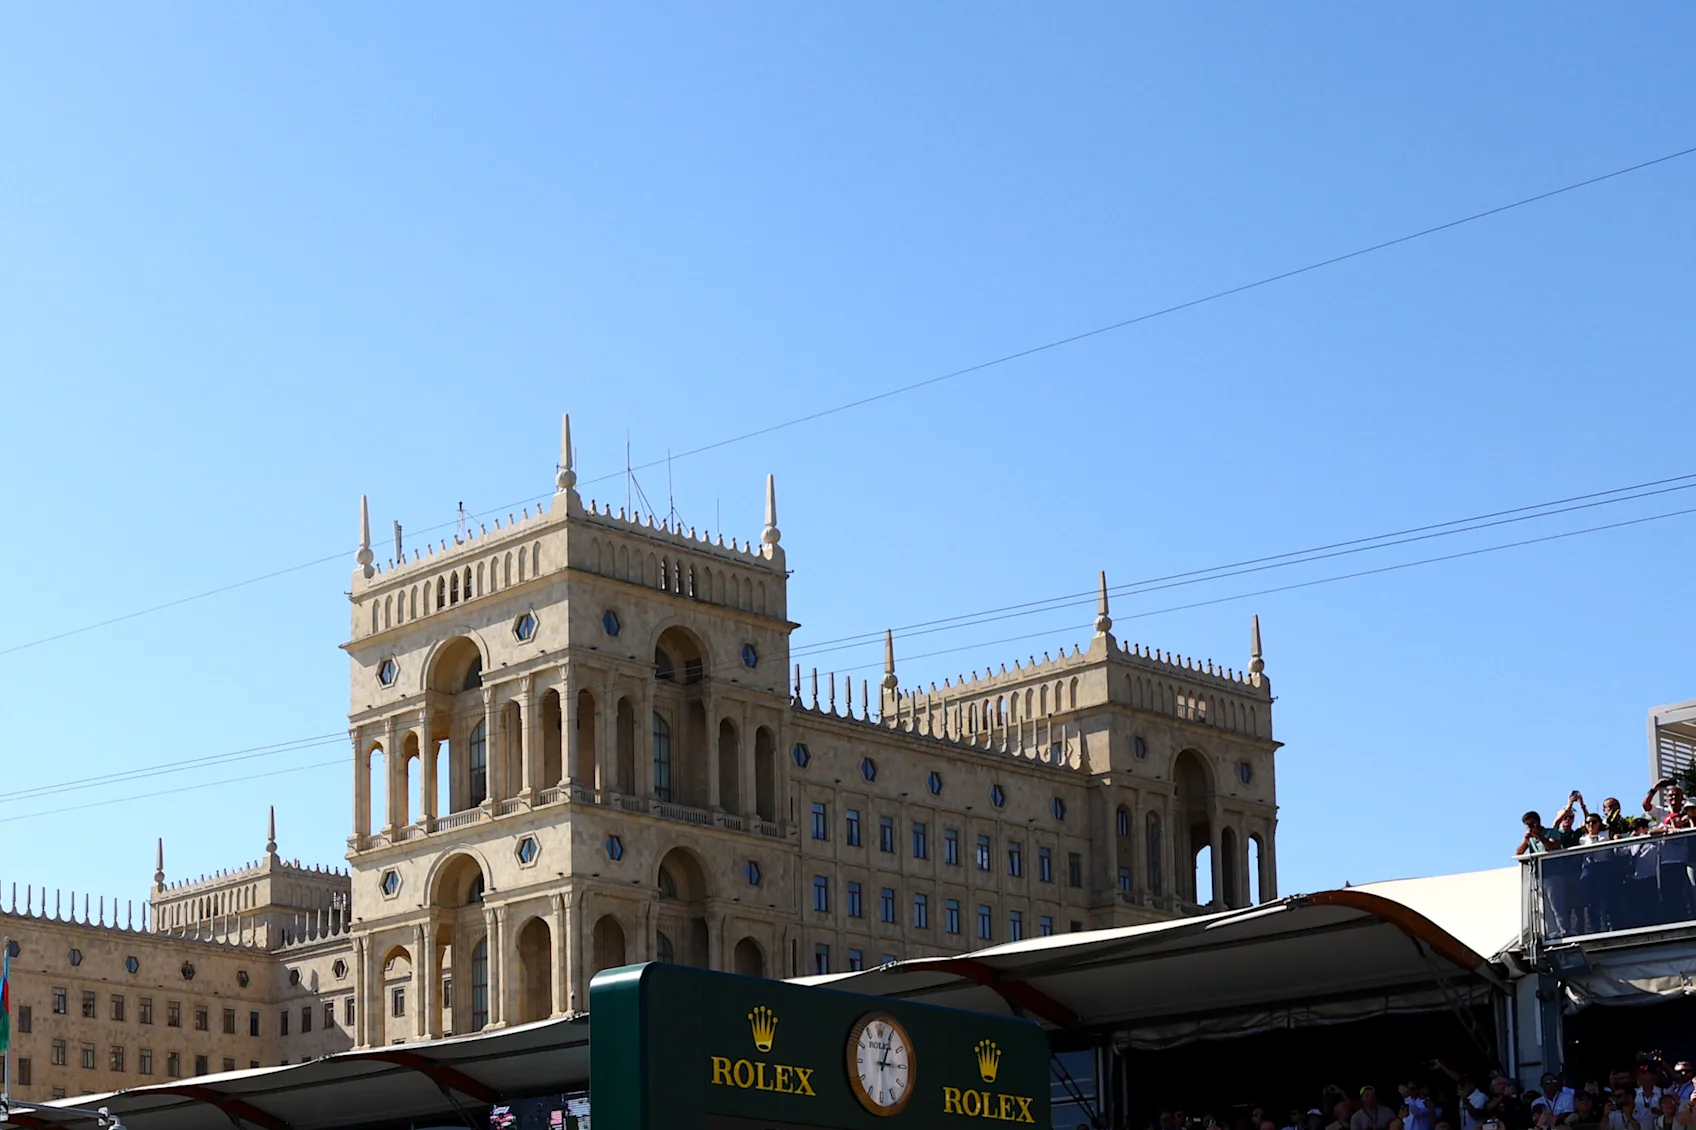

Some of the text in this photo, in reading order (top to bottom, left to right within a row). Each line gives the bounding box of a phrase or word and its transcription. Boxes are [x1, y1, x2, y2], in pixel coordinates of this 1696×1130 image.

[869, 1041, 891, 1050] ROLEX
[711, 1056, 816, 1096] ROLEX
[943, 1087, 1035, 1123] ROLEX
